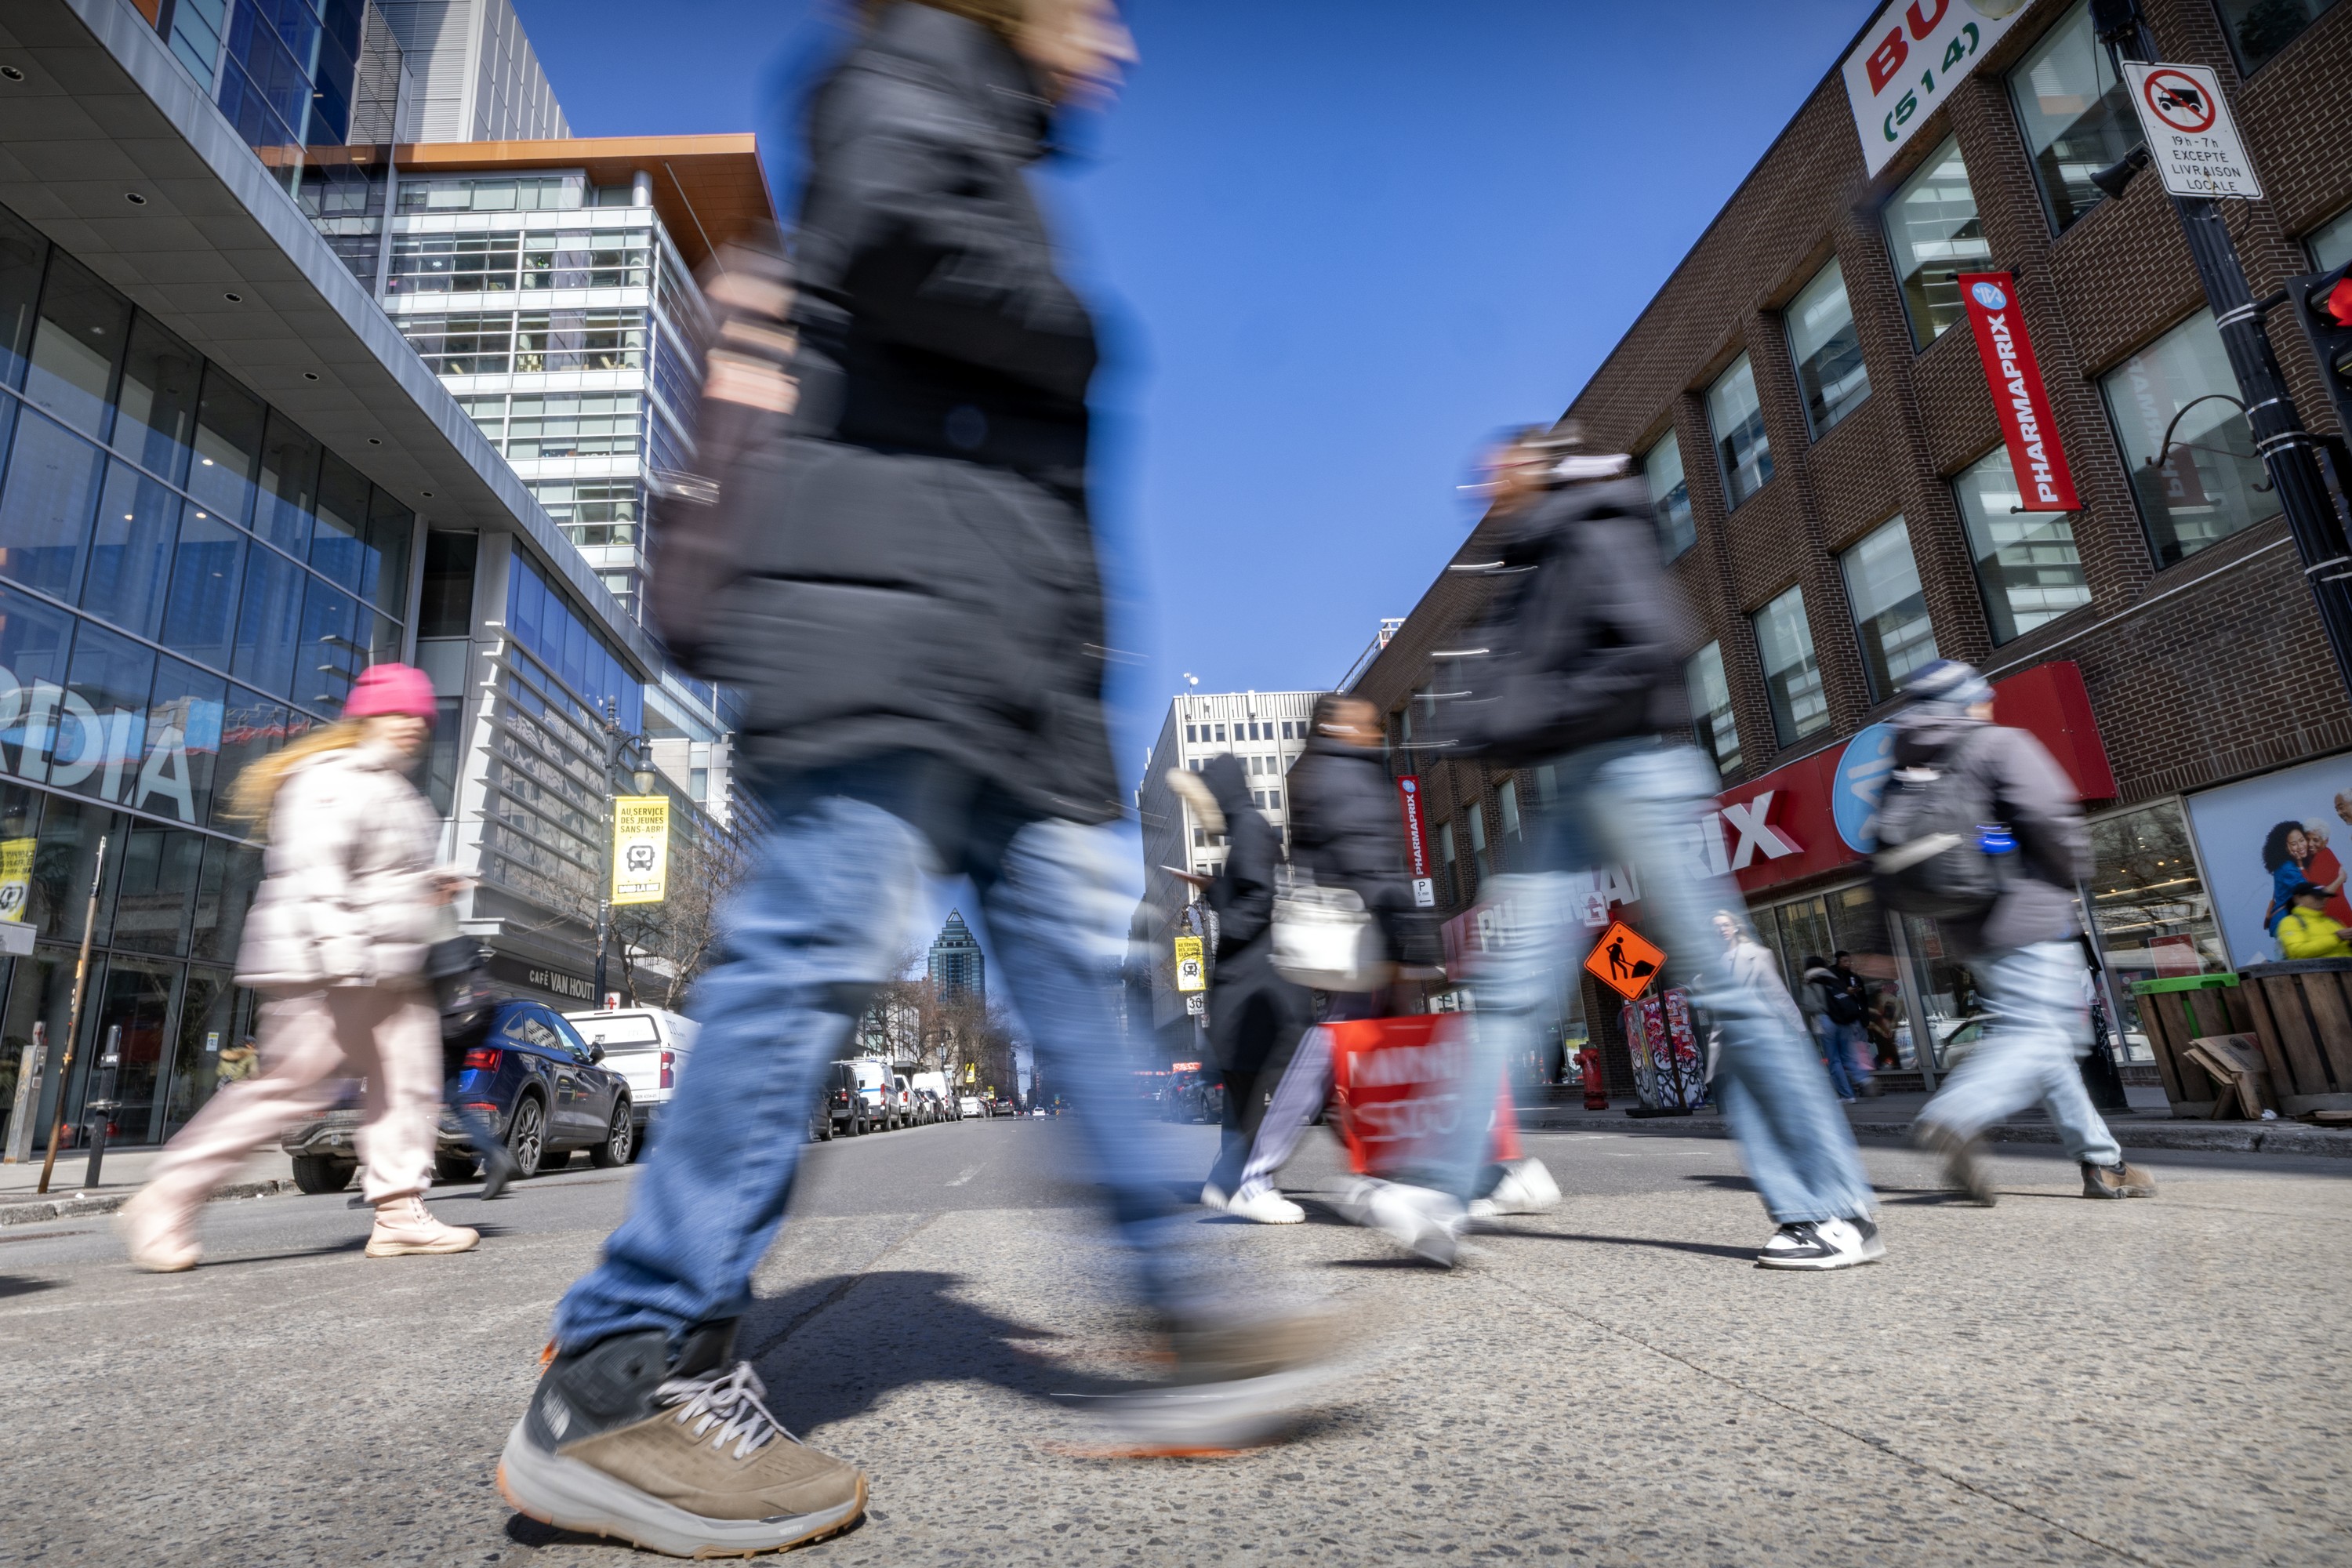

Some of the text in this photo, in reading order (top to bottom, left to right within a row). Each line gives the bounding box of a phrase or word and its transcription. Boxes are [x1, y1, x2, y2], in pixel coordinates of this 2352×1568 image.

[1865, 0, 1950, 98] BU
[2172, 150, 2229, 163] EXCEPTÉ
[2171, 164, 2241, 178] LIVRAISON
[2186, 179, 2238, 191] LOCALE
[1987, 314, 2059, 503] PHARMAPRIX
[633, 808, 664, 816] SERVICE
[1406, 794, 1424, 876] PHARMAPRIX
[1419, 881, 1425, 891] P
[529, 970, 596, 1000] CAFÉ VAN HOUTT
[1189, 997, 1202, 1009] 30
